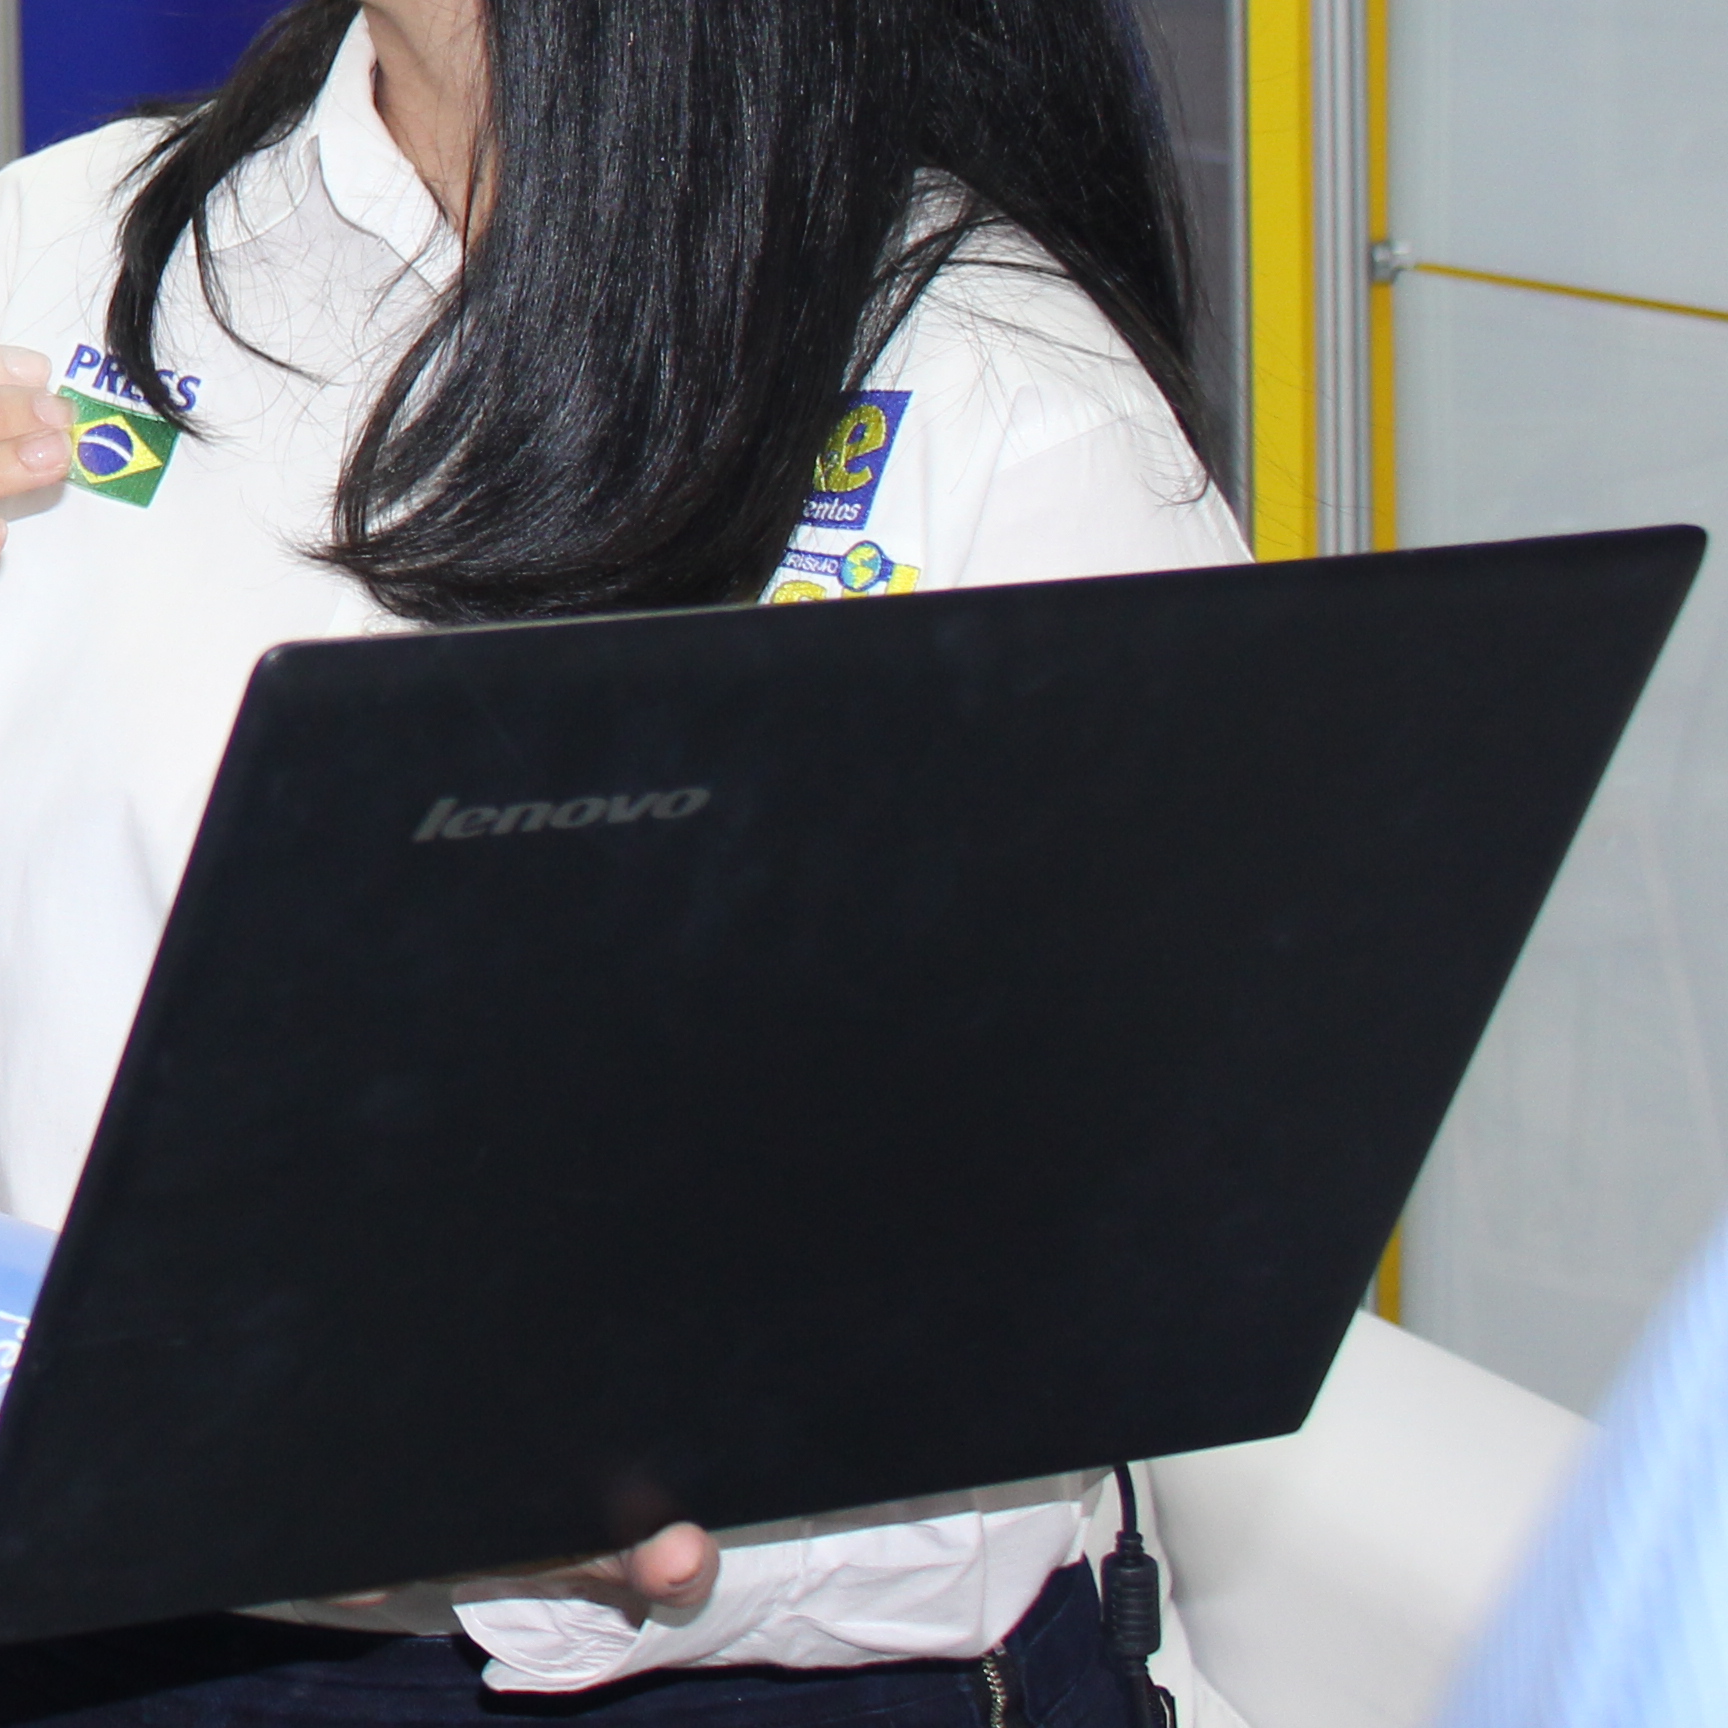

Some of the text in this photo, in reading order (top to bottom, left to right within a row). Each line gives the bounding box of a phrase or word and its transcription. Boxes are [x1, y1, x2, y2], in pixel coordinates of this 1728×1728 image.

[802, 497, 862, 521] entos
[783, 552, 839, 573] RISMO
[412, 786, 712, 842] lenovo
